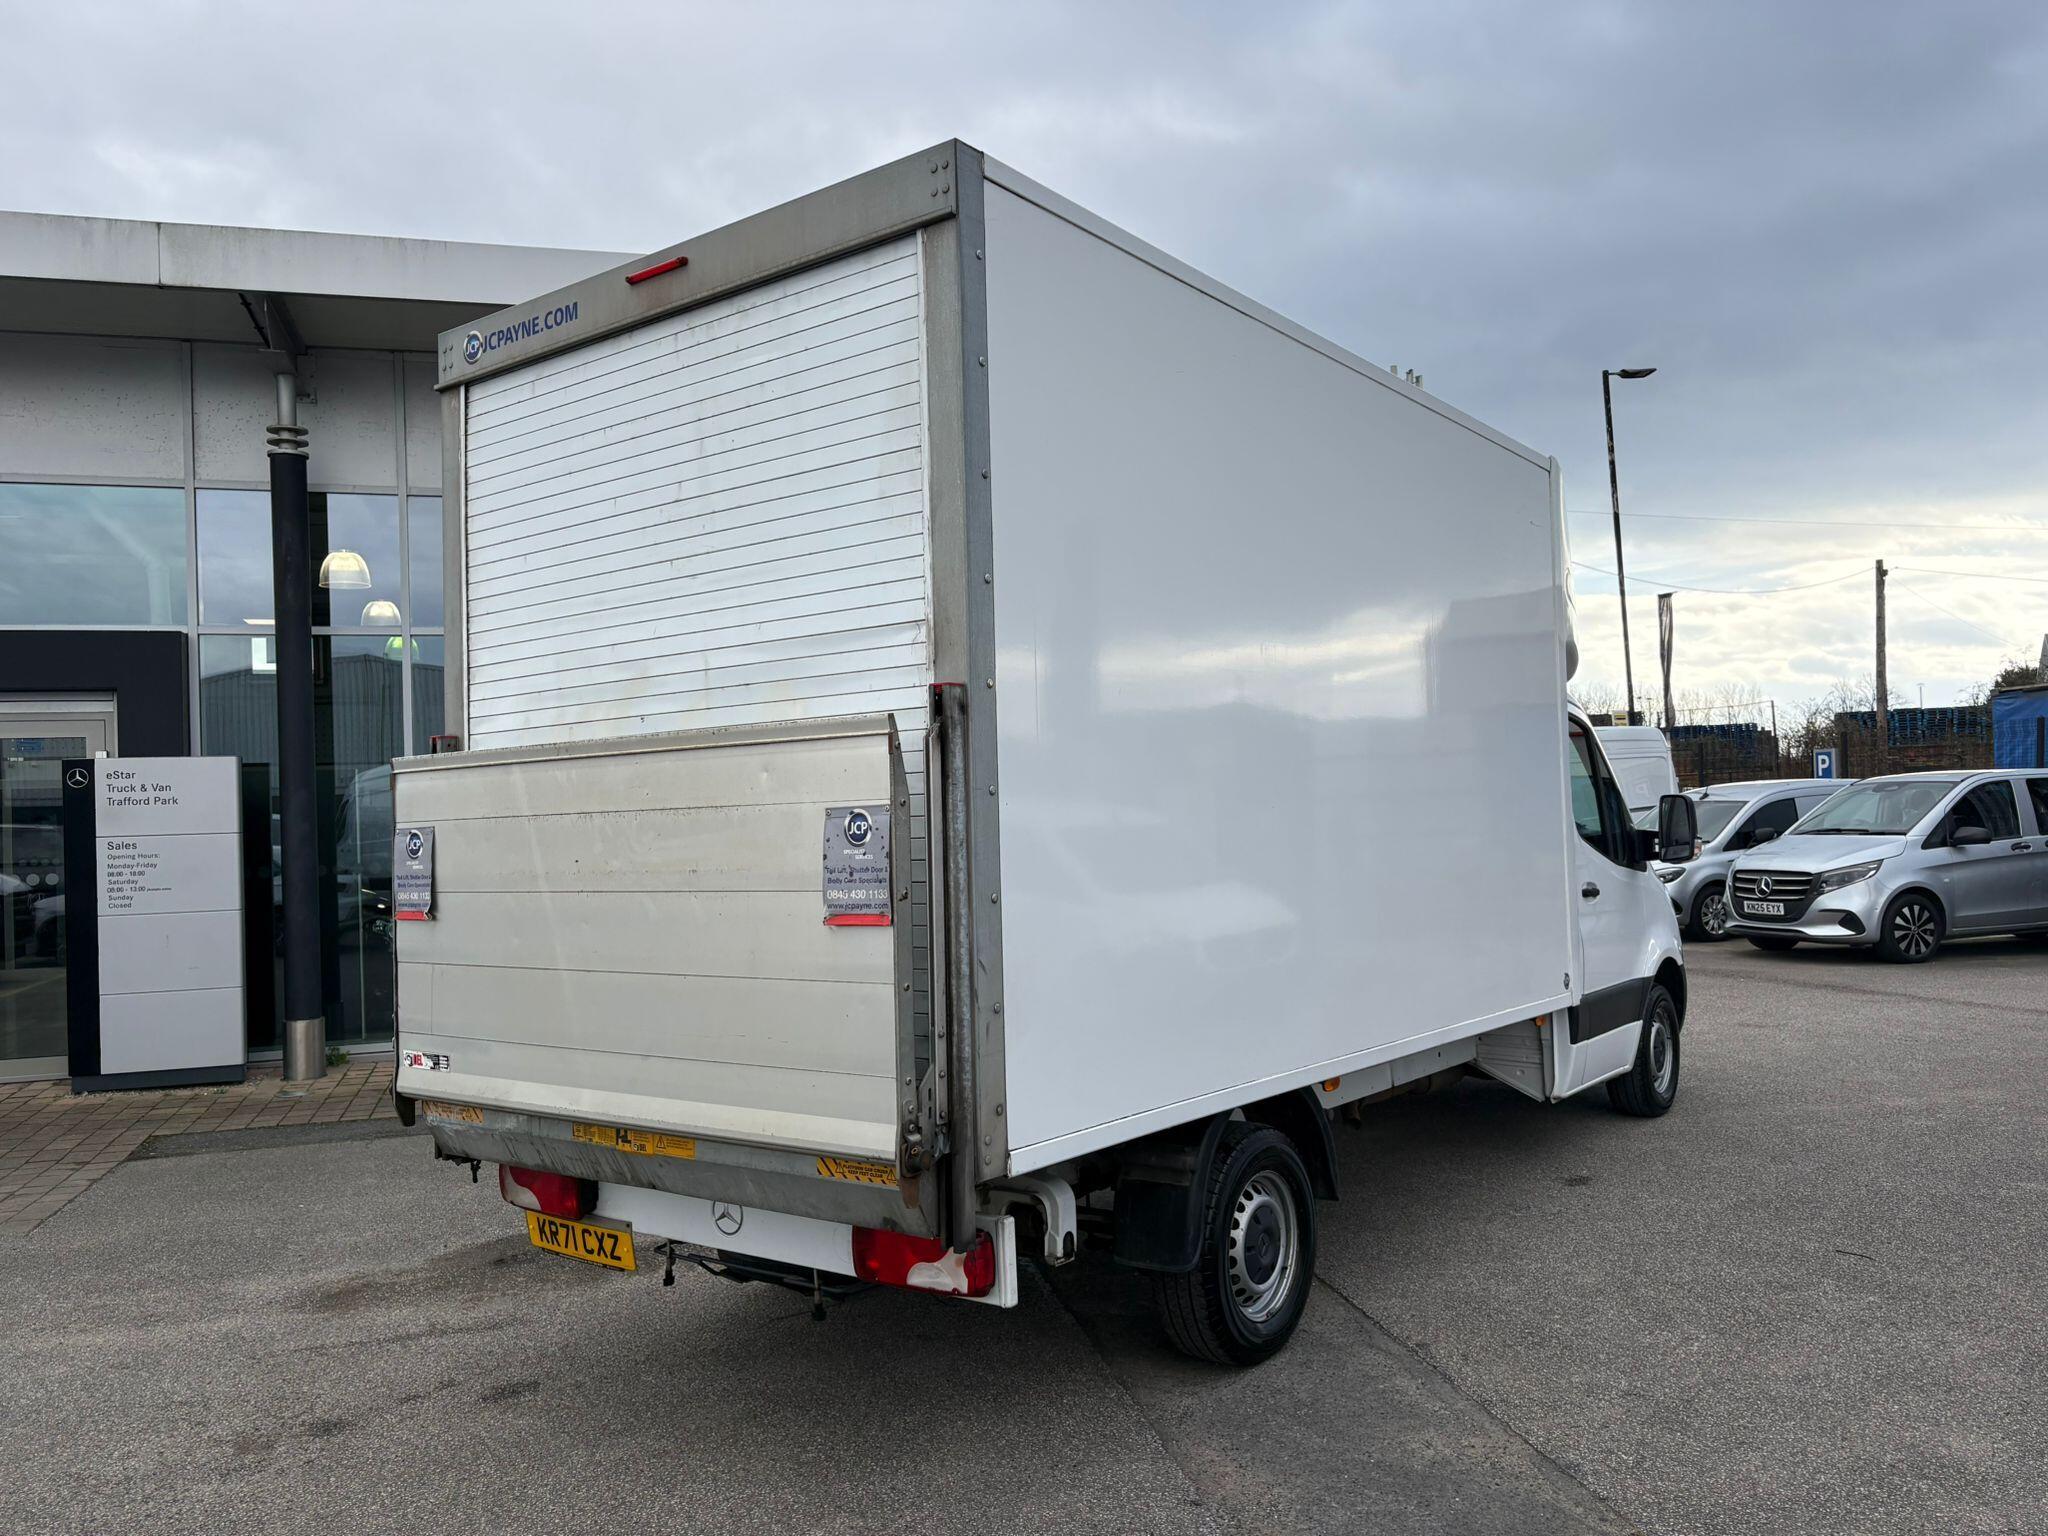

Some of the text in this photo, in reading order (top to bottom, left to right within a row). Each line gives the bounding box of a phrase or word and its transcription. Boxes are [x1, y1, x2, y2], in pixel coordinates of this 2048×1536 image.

[482, 301, 579, 353] JCPAYNE.COM
[465, 340, 480, 355] JCP
[1817, 755, 1830, 776] P
[106, 770, 136, 780] eStar
[106, 783, 172, 793] Truck & Van
[106, 796, 179, 806] Trafford Park
[849, 821, 868, 835] JCP
[107, 841, 137, 851] Sales
[409, 839, 421, 850] JCP
[870, 865, 884, 873] Door
[827, 876, 843, 885] Body
[826, 889, 888, 899] 0845 430 1133
[826, 901, 889, 912] www.jcpayne.com
[1766, 903, 1782, 914] EYX
[536, 1216, 622, 1262] KR71 CXZ
